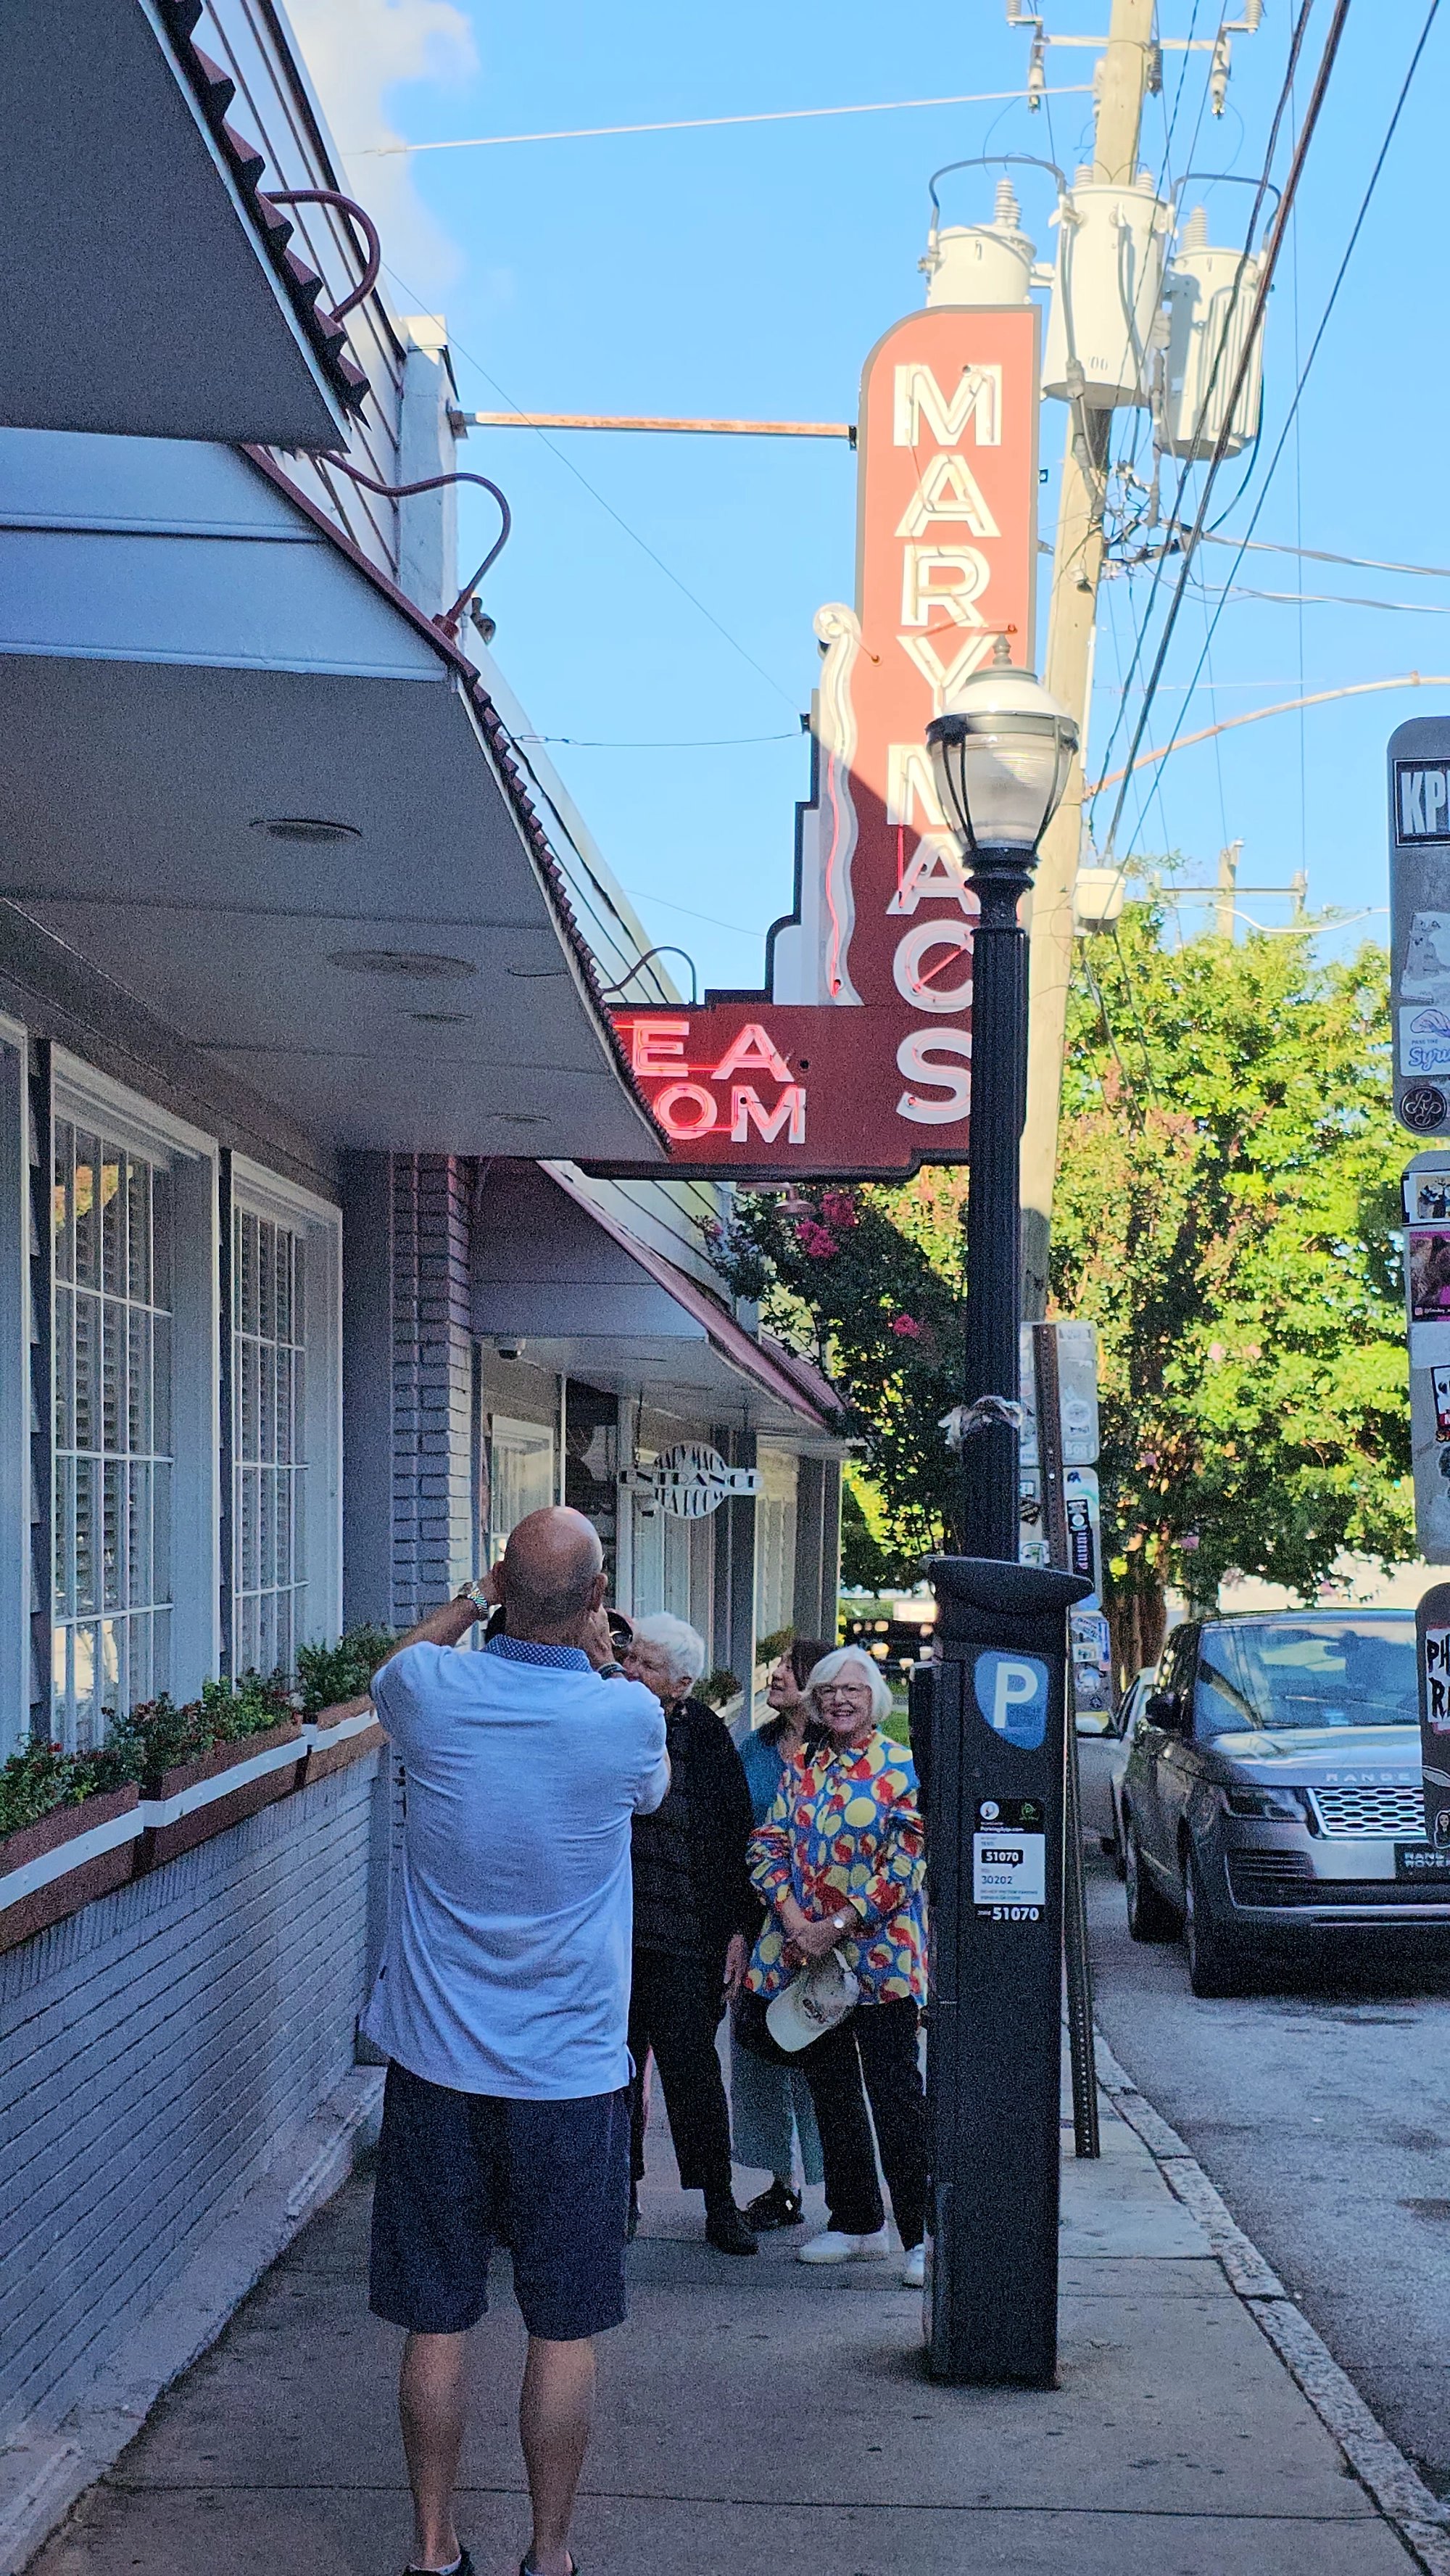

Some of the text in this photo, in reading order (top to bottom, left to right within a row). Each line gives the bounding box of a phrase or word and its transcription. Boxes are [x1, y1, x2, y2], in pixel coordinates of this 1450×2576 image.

[893, 365, 1002, 716] MARY
[1401, 770, 1450, 834] KP
[632, 1020, 795, 1082] EA
[653, 1083, 805, 1144] OM
[619, 1470, 762, 1488] ENTRANCE
[993, 1662, 1038, 1729] P
[1325, 1773, 1411, 1782] RANGE
[986, 1852, 1019, 1862] 51070
[982, 1875, 1014, 1884] 30202
[993, 1907, 1040, 1921] 51070
